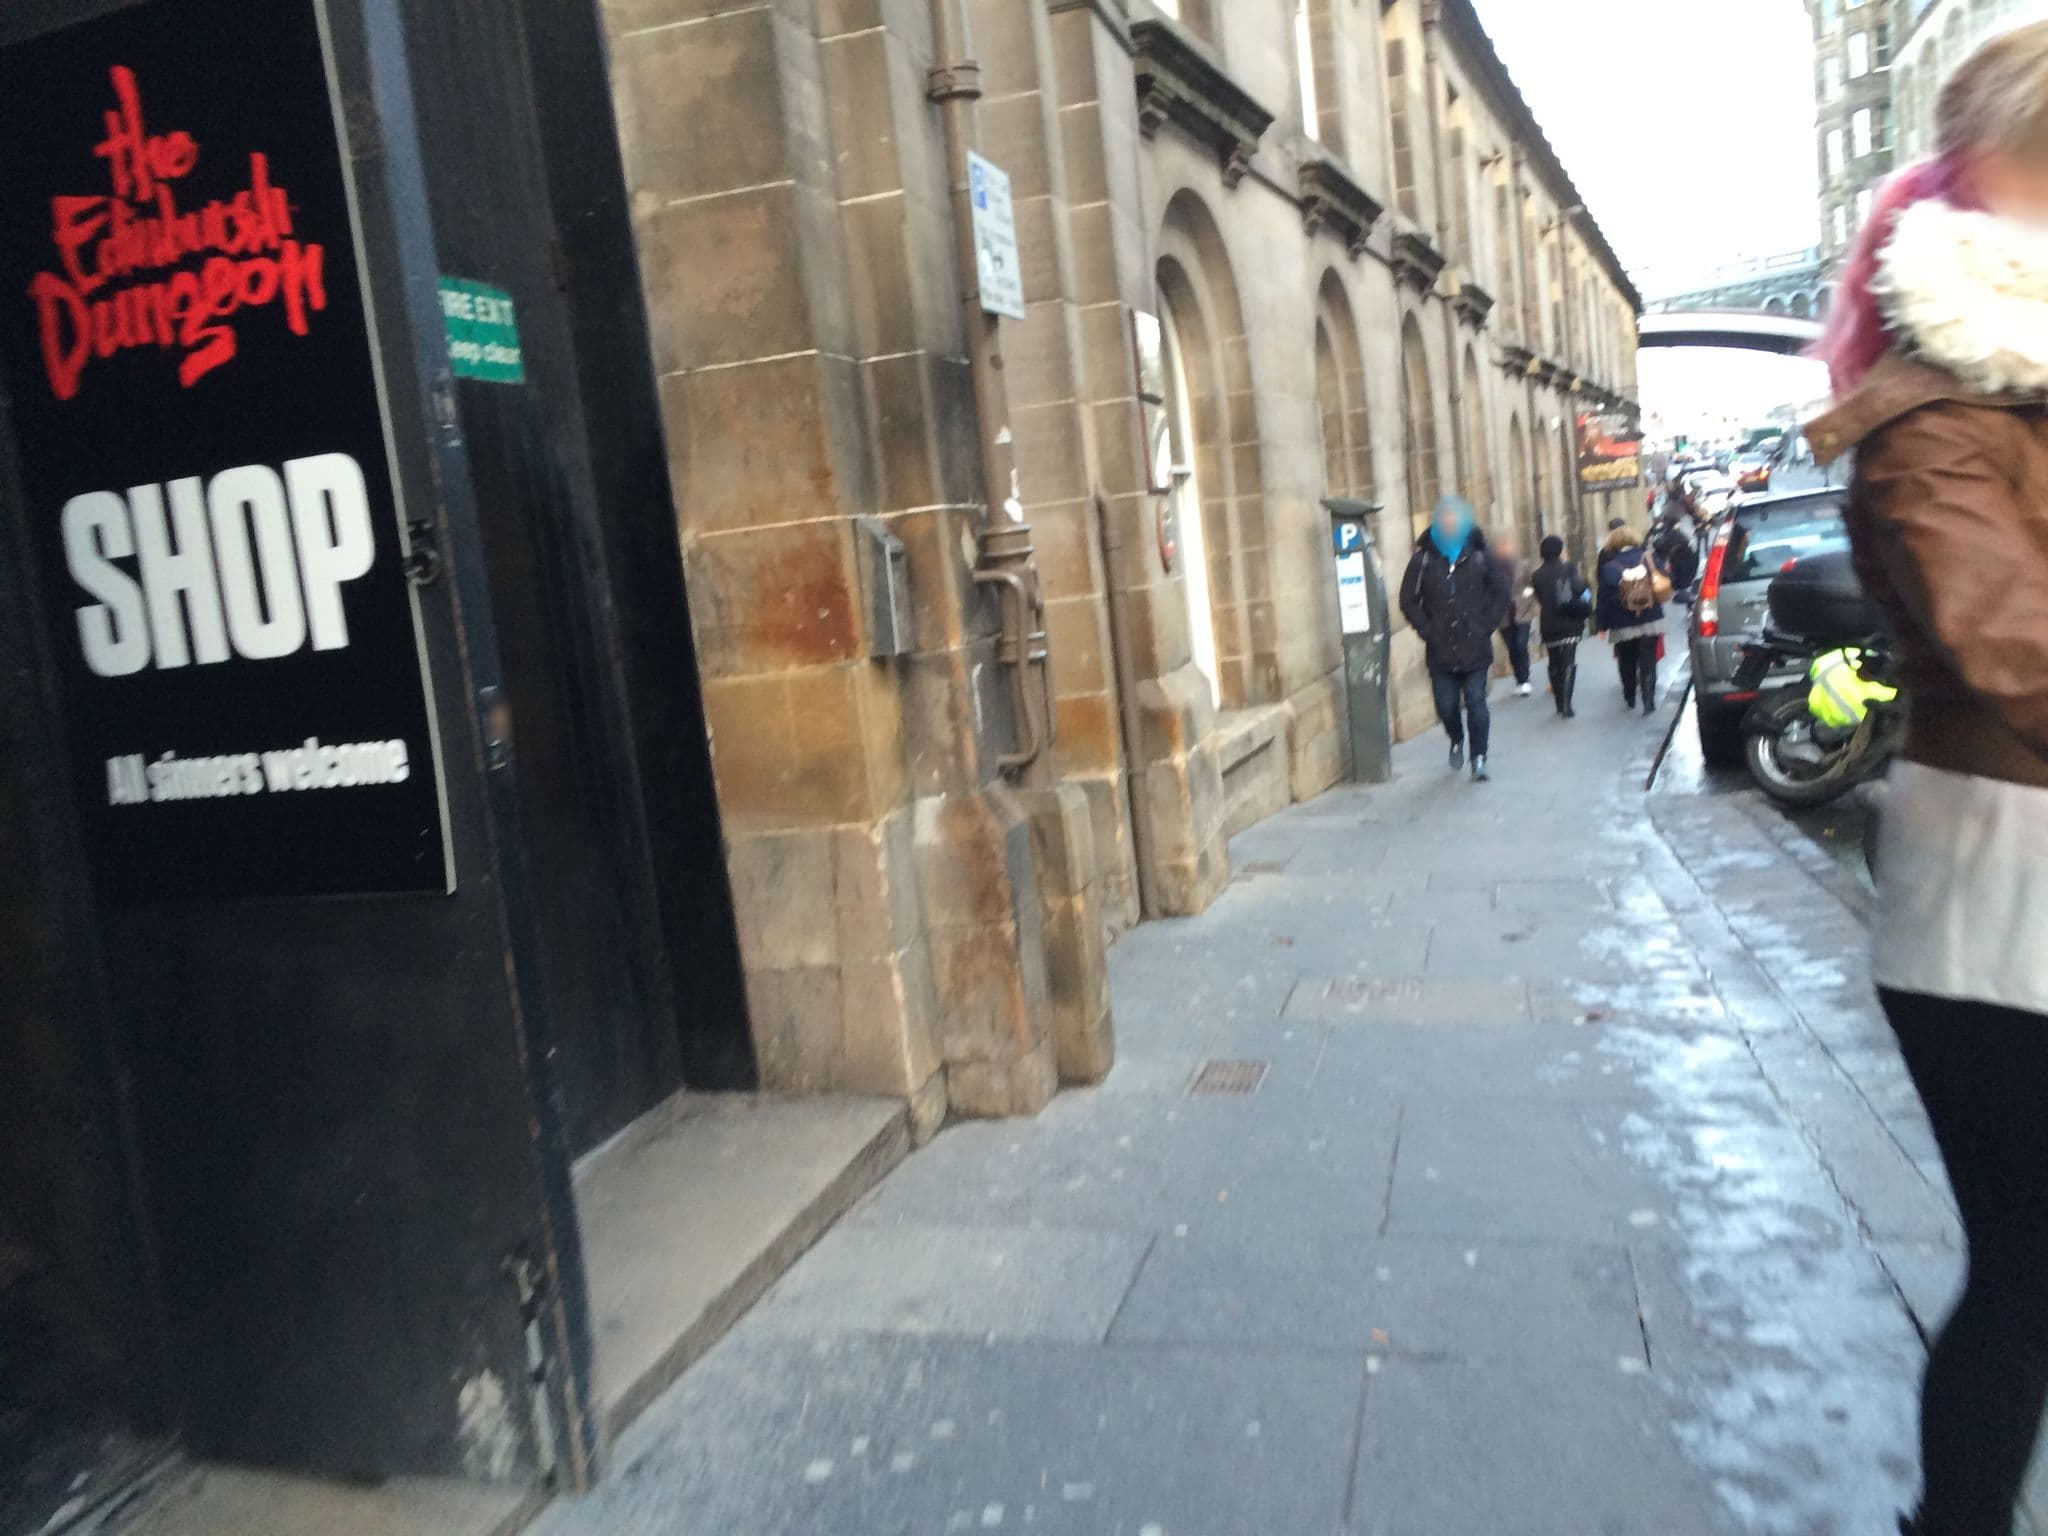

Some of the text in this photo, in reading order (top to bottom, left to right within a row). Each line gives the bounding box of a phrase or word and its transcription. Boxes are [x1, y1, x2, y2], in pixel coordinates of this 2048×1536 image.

[94, 65, 199, 201] the
[28, 238, 325, 399] Dungeon
[474, 295, 514, 327] EXIT
[61, 452, 376, 677] SHOP
[1340, 523, 1358, 549] P
[106, 736, 410, 805] All sinners welcome
